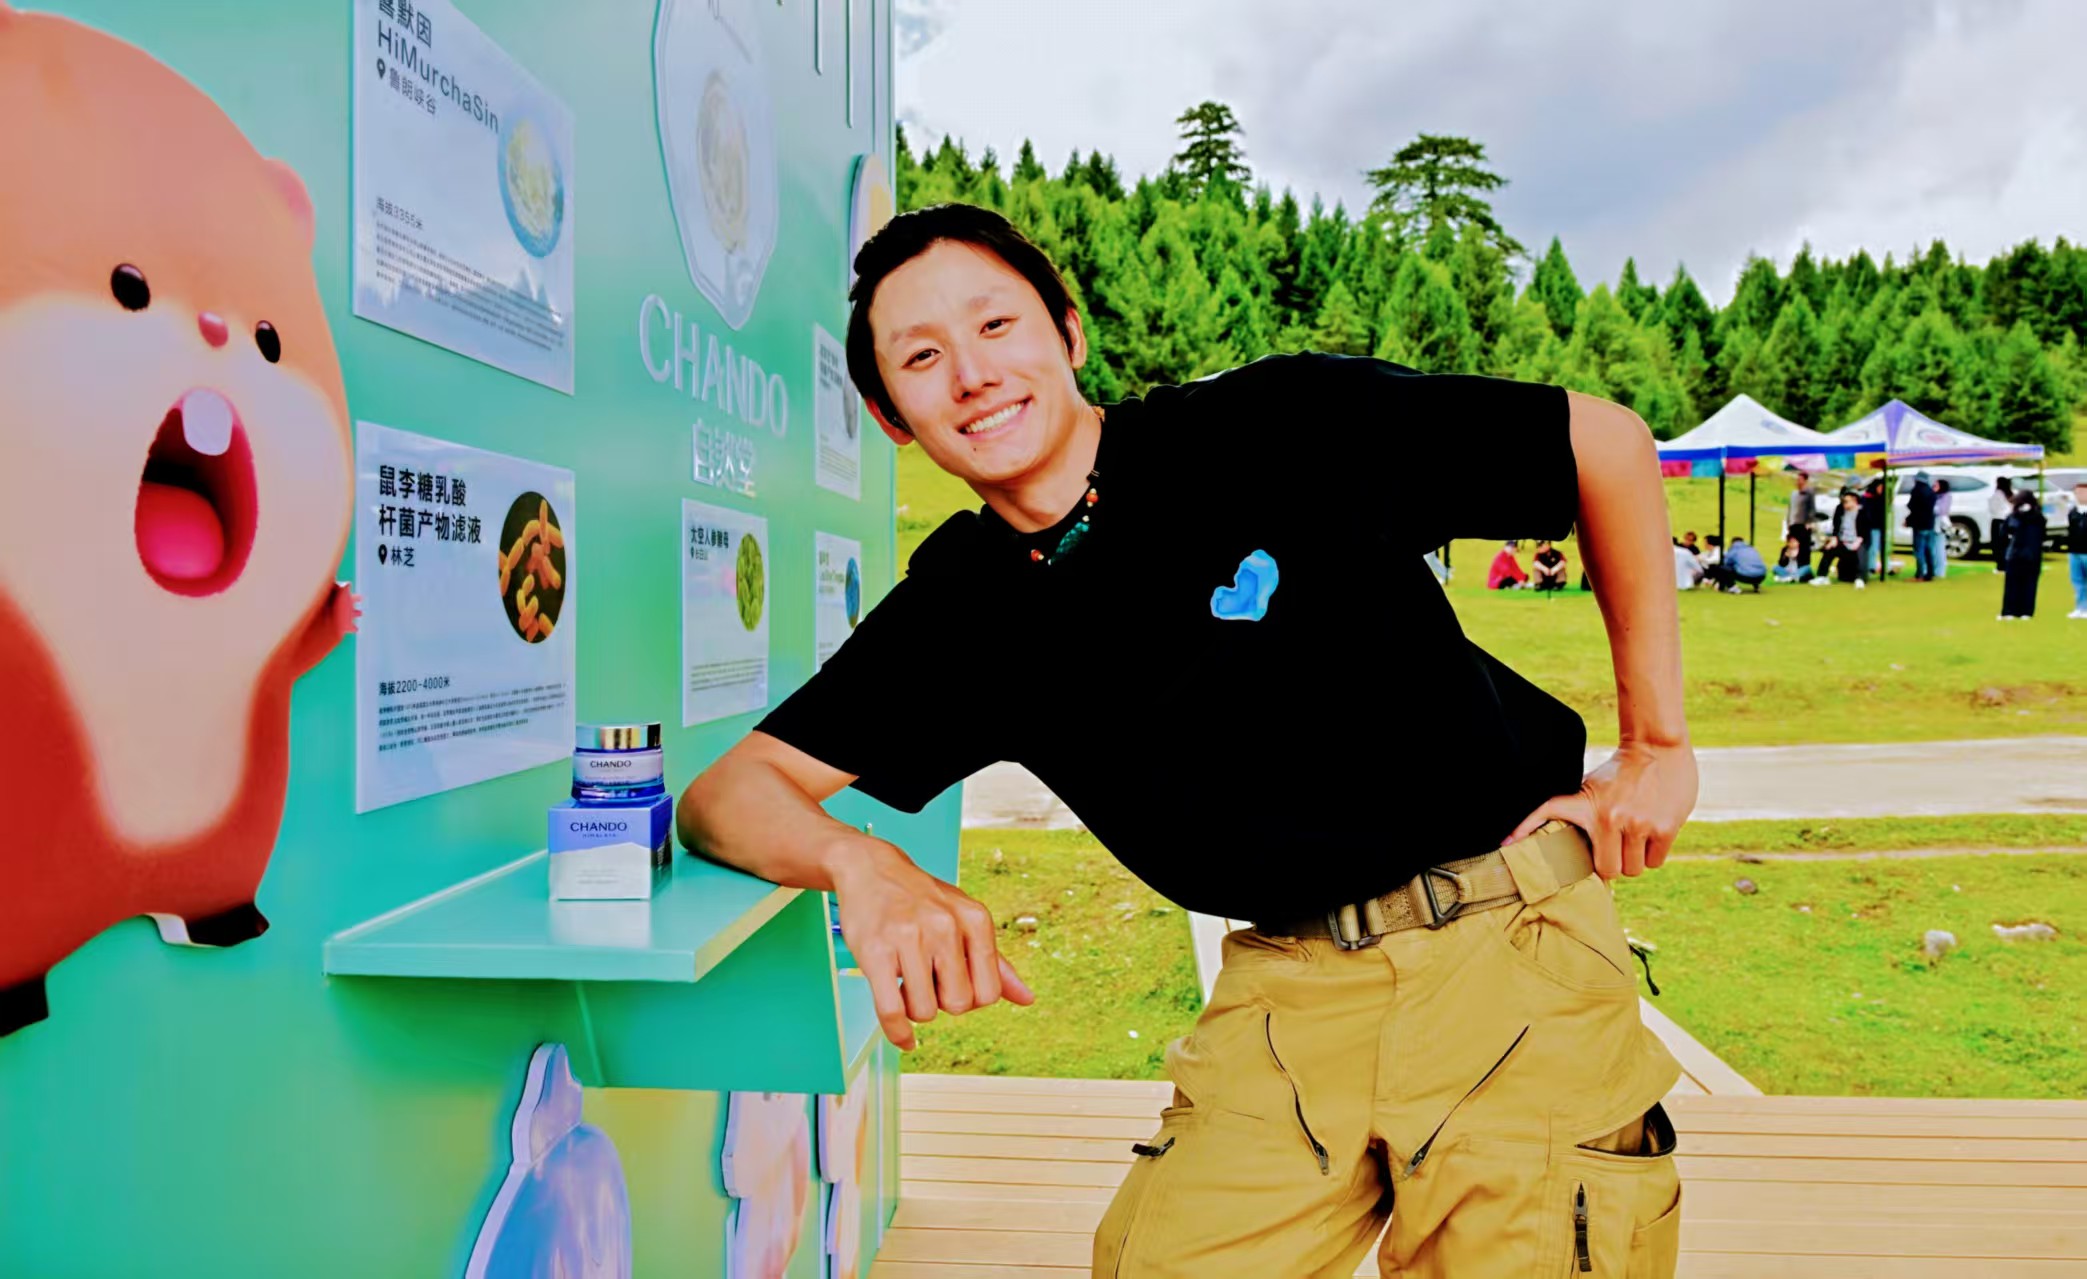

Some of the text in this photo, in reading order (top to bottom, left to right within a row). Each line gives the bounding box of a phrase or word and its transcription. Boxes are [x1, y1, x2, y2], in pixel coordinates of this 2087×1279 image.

[378, 20, 498, 133] HiMurchaSin
[639, 294, 789, 438] CHANDO
[379, 465, 467, 507] 鼠李糖乳酸
[378, 504, 482, 544] 杆菌产物滤液
[390, 546, 415, 567] 林芝
[378, 676, 450, 696] 海拔2200-4000米
[589, 760, 632, 768] CHANDO
[570, 822, 627, 832] CHANDO
